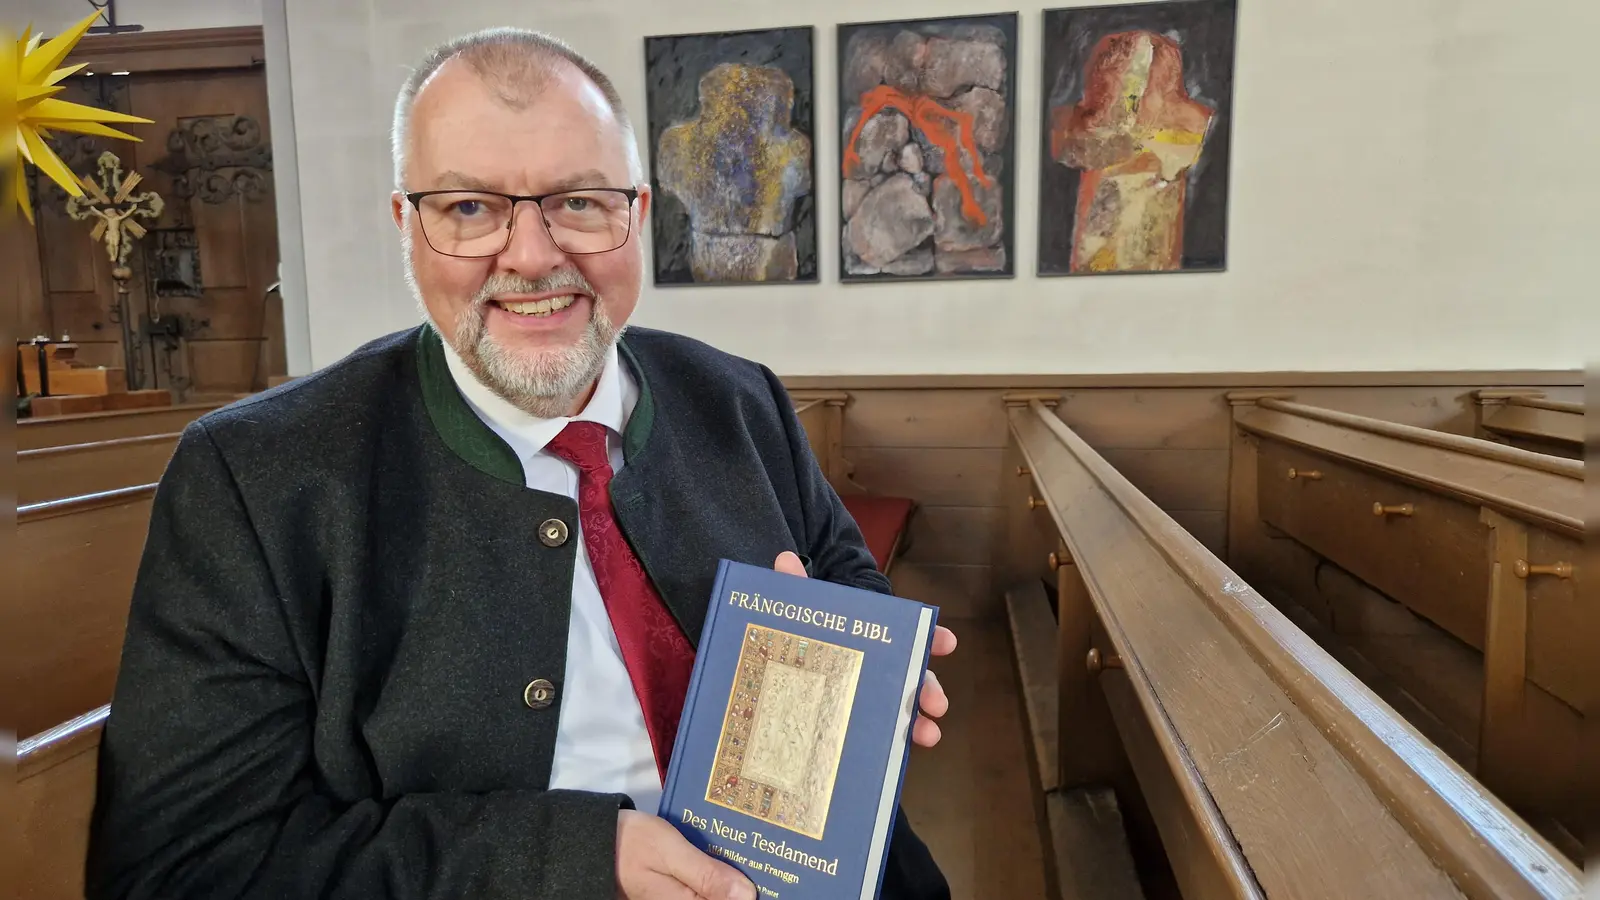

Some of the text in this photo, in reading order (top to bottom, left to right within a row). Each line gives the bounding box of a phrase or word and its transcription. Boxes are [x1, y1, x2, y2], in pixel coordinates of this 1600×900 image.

[729, 591, 892, 643] FRÄNGGISCHE BIBL
[682, 808, 839, 876] Des Neue Tesdamend
[724, 849, 748, 865] Bilder
[748, 859, 763, 871] aus
[765, 863, 800, 885] Franggn
